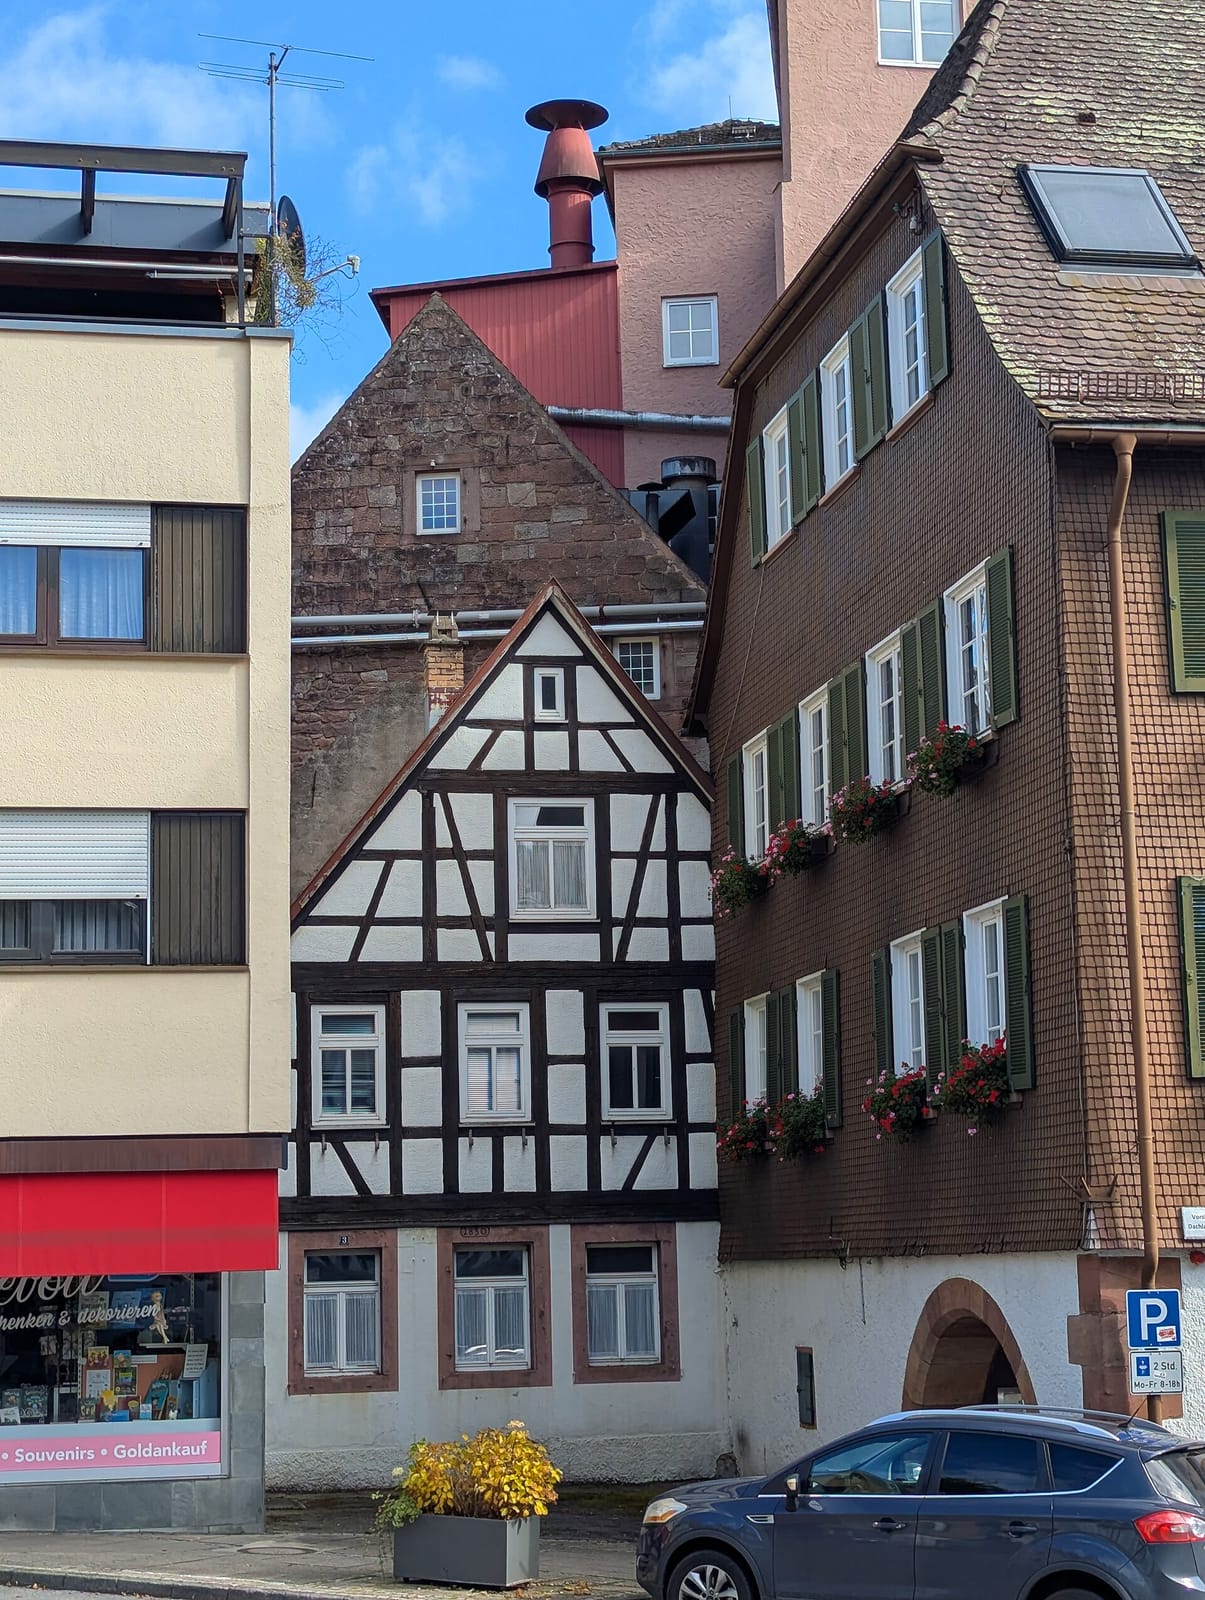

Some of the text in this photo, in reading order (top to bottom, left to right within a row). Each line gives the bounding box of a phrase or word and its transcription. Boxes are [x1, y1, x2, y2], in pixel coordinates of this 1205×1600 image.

[58, 1311, 71, 1326] &
[77, 1304, 158, 1324] dekorieren
[1139, 1298, 1168, 1341] P
[1153, 1362, 1178, 1370] 2 Std.
[1160, 1380, 1180, 1388] 8-18h
[15, 1441, 207, 1462] Souvenirs Goldankauf
